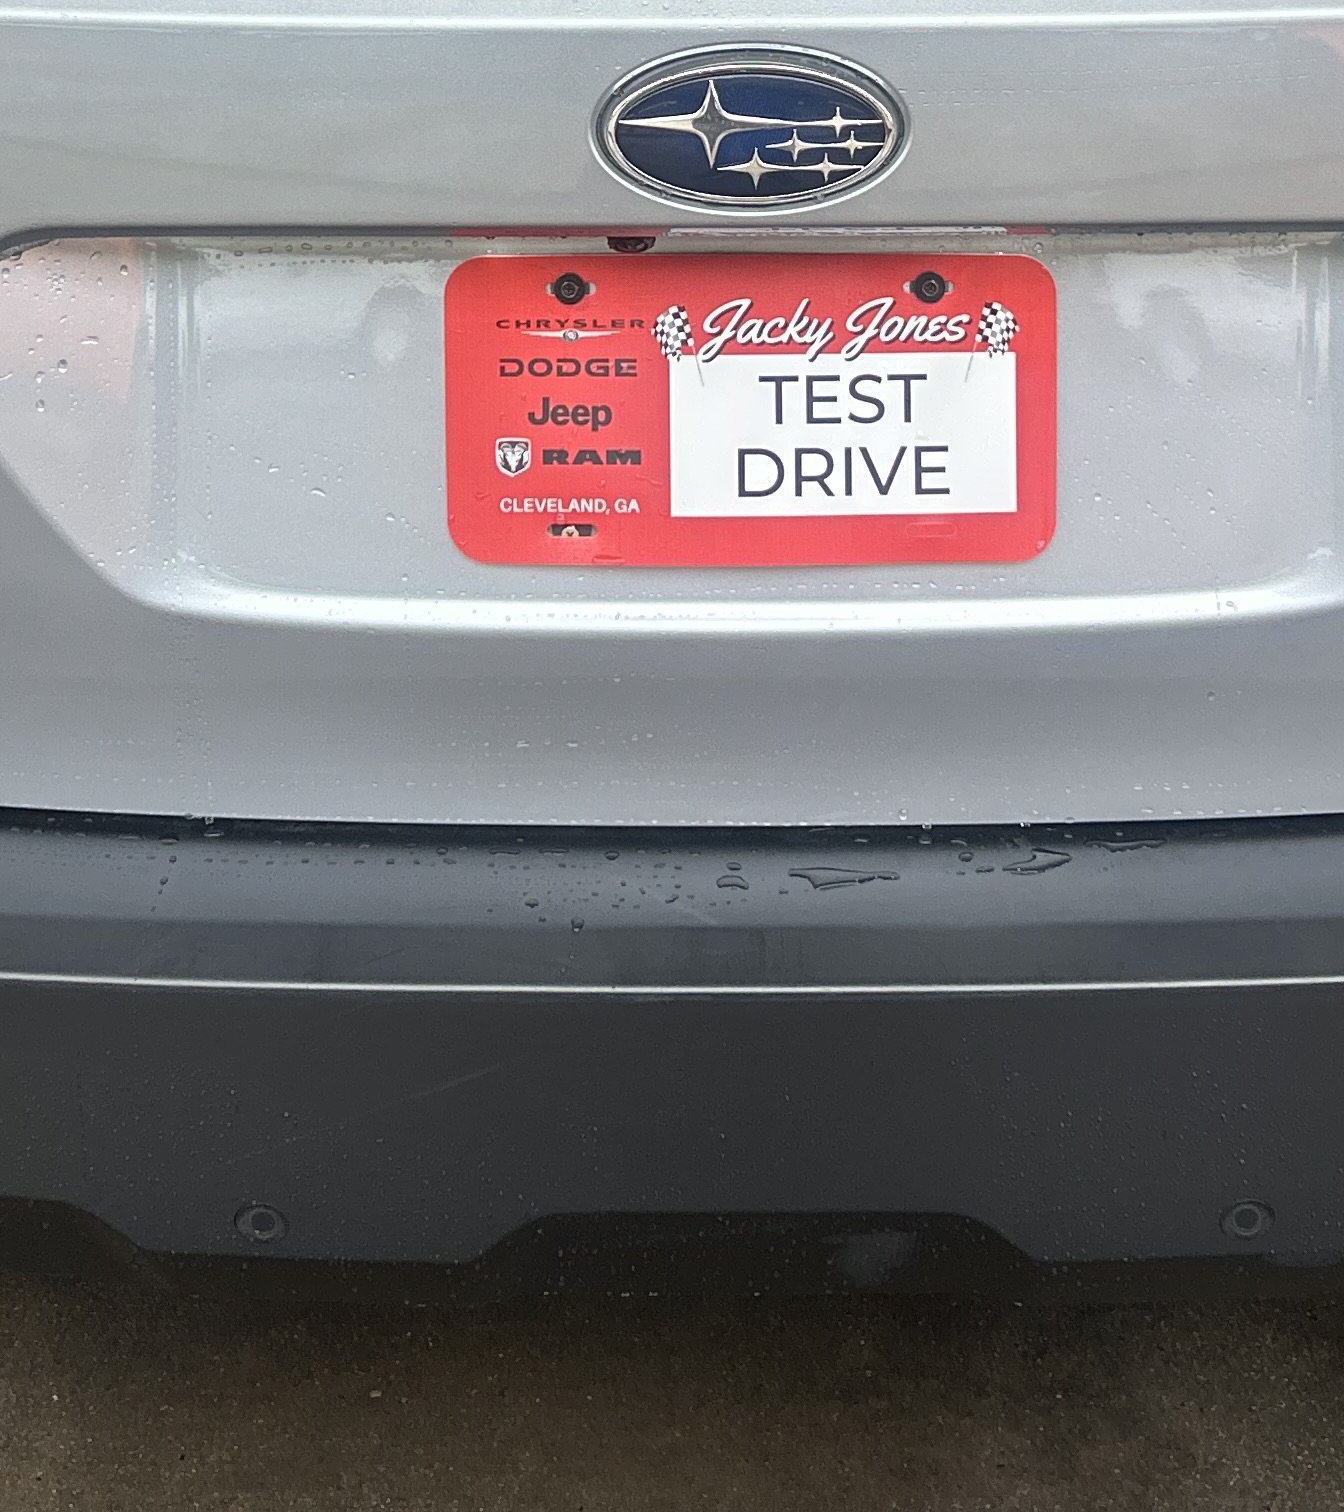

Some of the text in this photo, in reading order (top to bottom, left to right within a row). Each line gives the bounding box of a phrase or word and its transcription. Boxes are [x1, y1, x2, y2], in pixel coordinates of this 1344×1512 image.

[496, 318, 645, 331] CHRYSLER
[702, 298, 971, 363] Jacky Jones
[499, 358, 638, 378] DODGE
[758, 374, 928, 424] TEST
[528, 397, 613, 432] Jeep
[542, 449, 641, 466] RAM
[737, 445, 951, 498] DRIVE
[499, 497, 640, 515] CLEVELAND, GA
